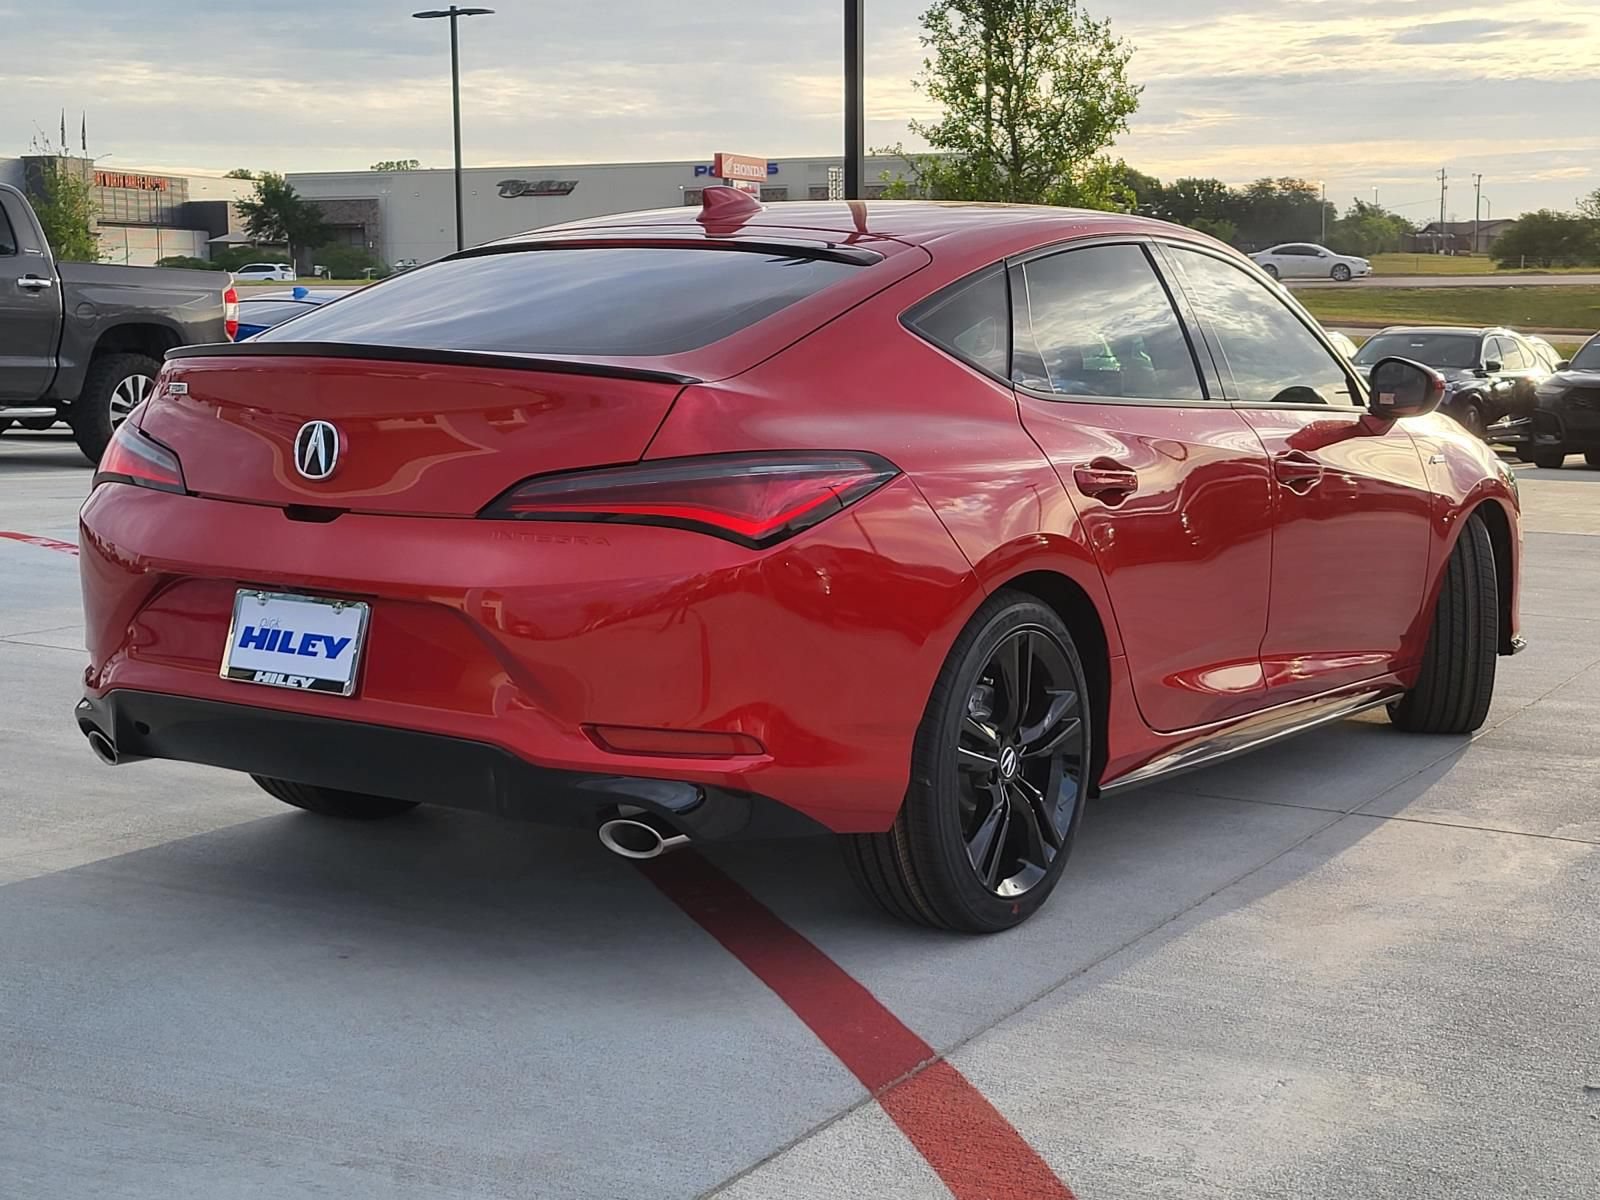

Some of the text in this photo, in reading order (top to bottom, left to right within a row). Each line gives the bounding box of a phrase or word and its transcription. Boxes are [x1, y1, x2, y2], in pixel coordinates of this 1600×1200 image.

[733, 162, 766, 177] HONDA
[490, 530, 612, 546] INTEGRA
[238, 626, 352, 659] HILEY
[253, 671, 316, 688] HILEY
